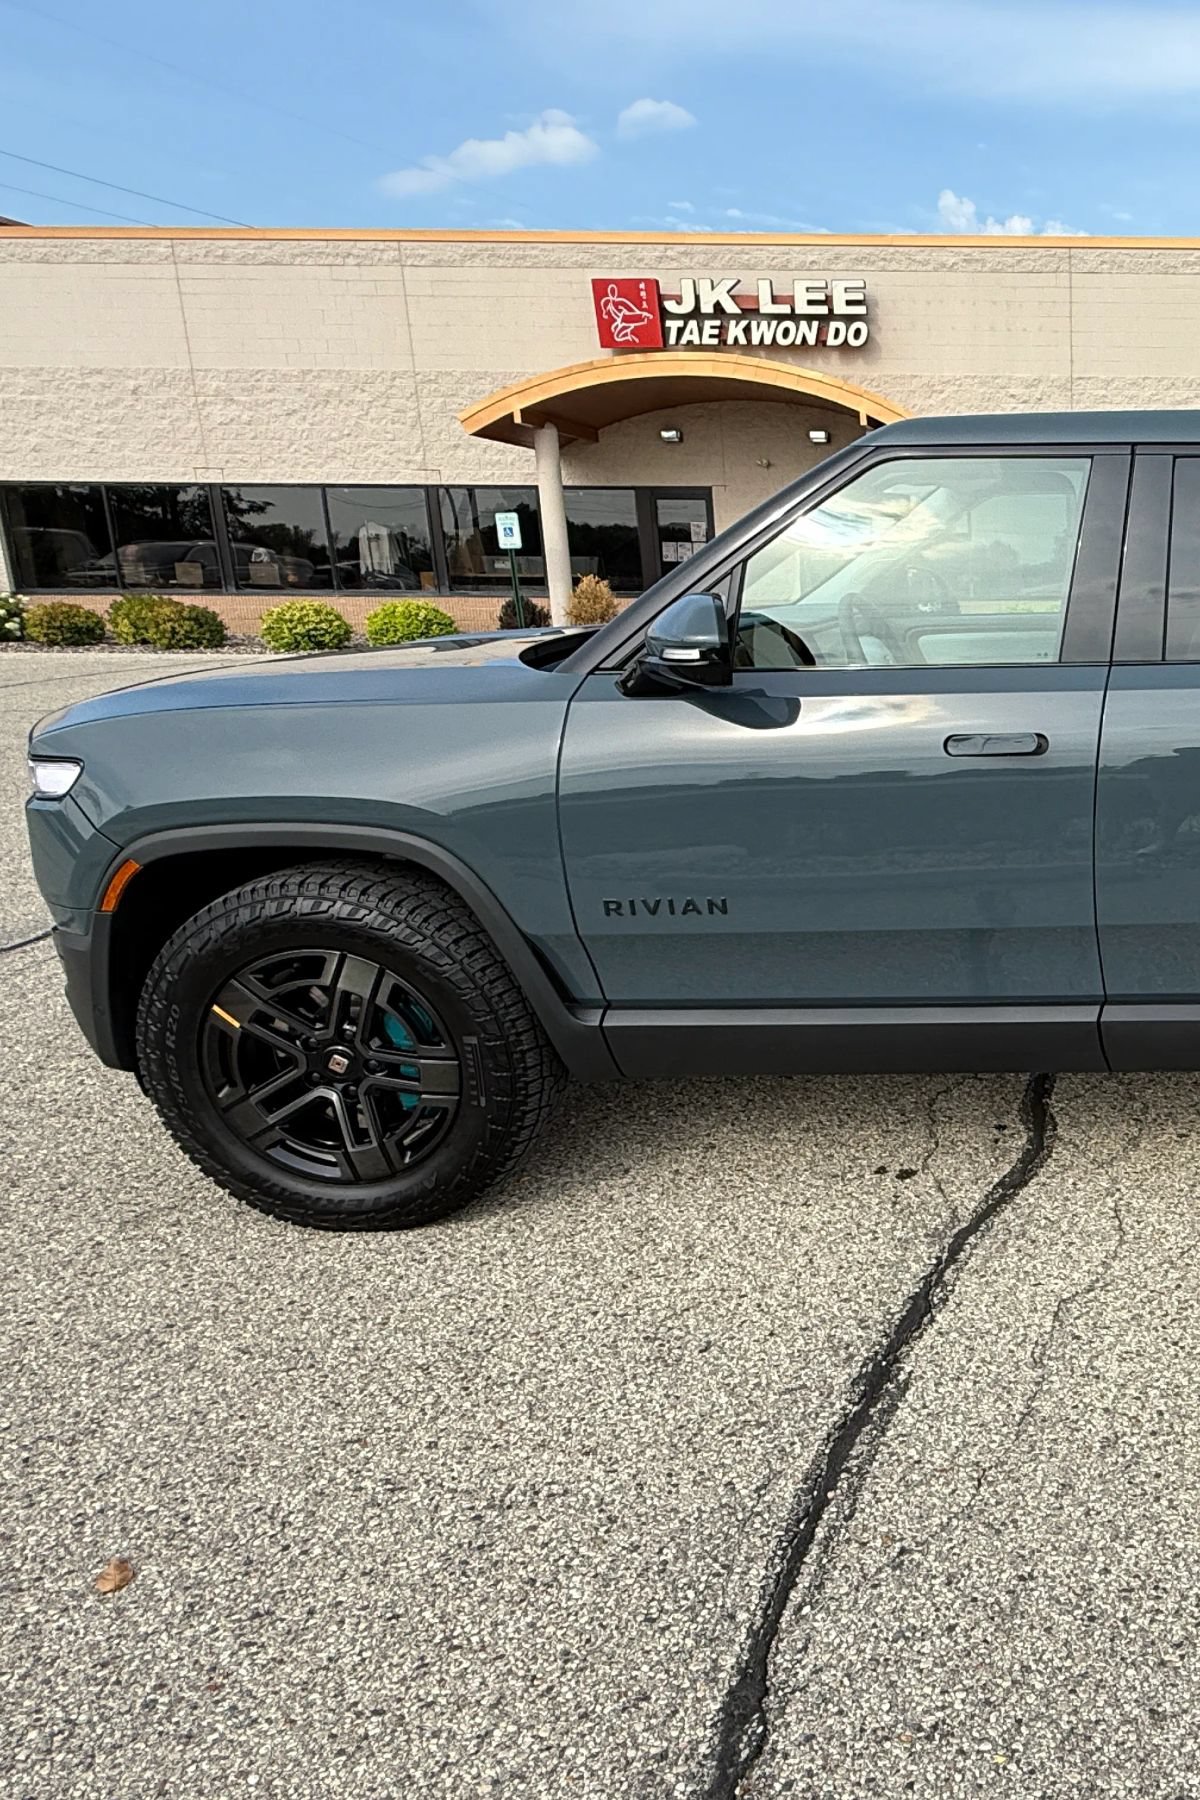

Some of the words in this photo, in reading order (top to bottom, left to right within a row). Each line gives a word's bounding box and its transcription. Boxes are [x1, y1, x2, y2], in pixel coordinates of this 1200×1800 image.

[663, 278, 741, 314] JK
[757, 278, 867, 314] LEE
[665, 320, 721, 345] TAE
[727, 320, 819, 346] KWON
[826, 321, 868, 347] DO
[602, 897, 728, 917] RIVIAN
[165, 1003, 182, 1048] R20
